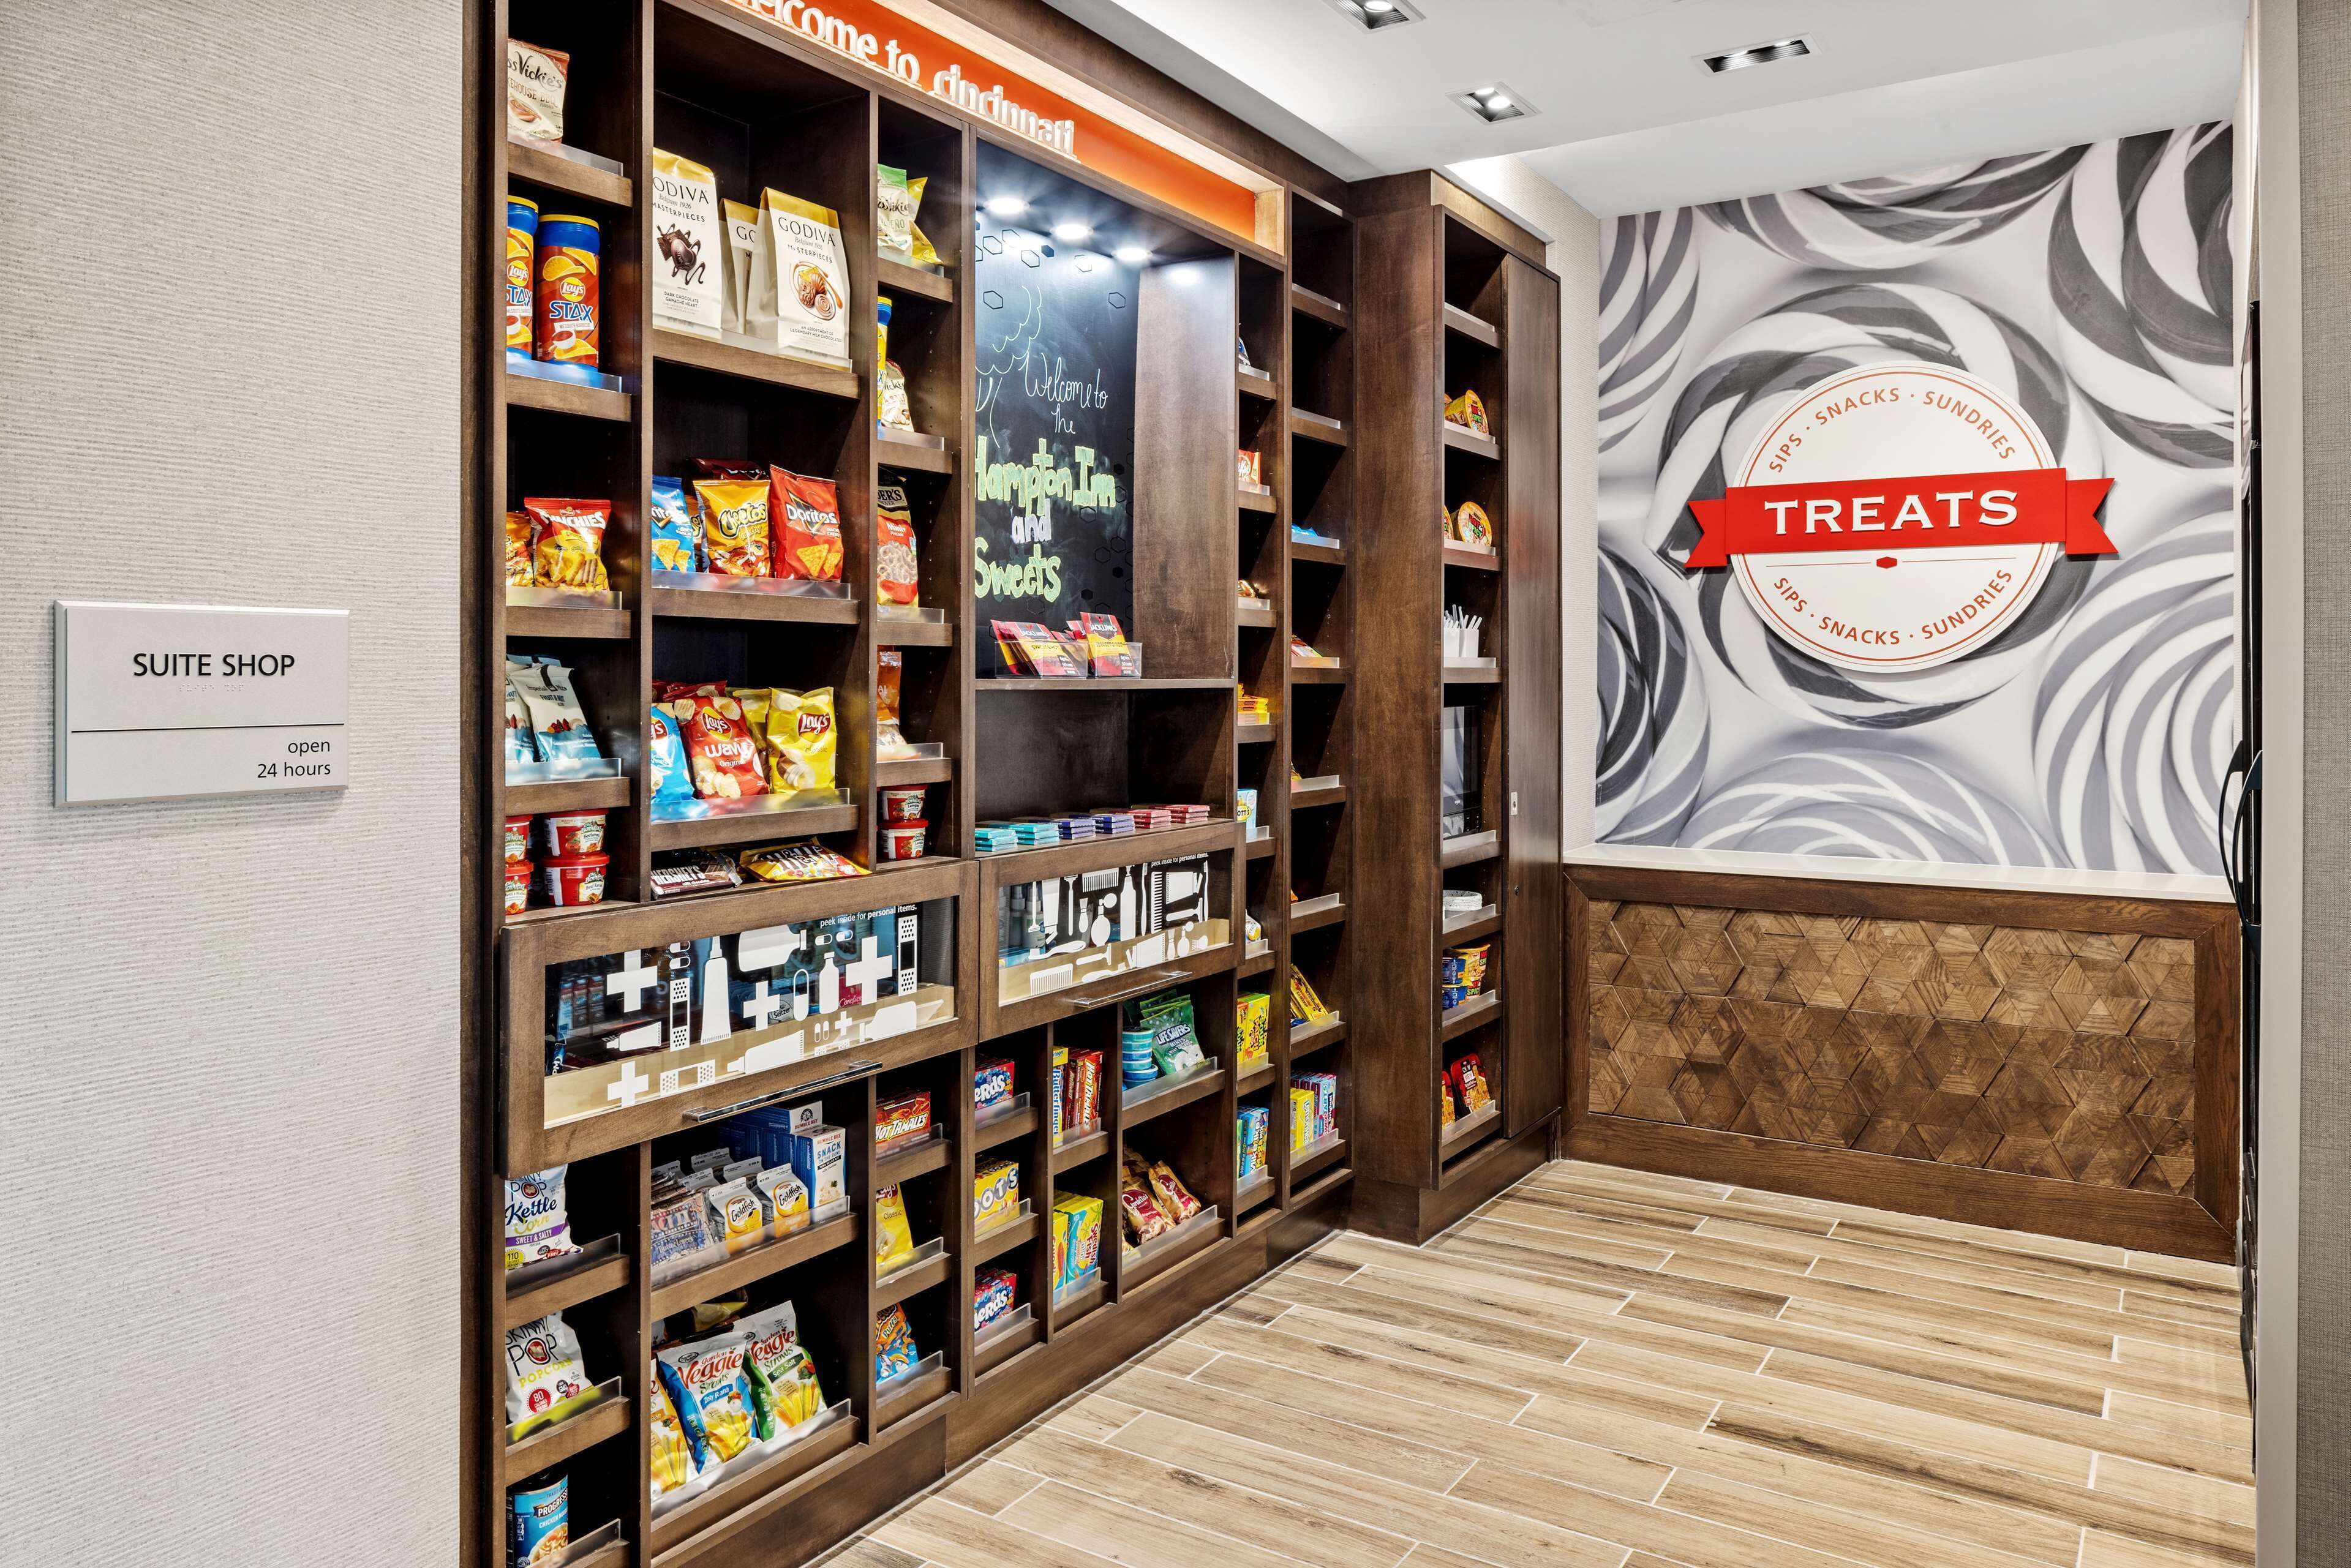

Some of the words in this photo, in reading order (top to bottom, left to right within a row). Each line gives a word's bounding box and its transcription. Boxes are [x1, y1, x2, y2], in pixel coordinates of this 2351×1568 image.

[886, 40, 920, 84] to
[933, 64, 1075, 157] cincinnati
[653, 176, 709, 204] ODIVA
[778, 216, 836, 247] GODIVA
[507, 284, 533, 309] TAX
[675, 294, 699, 304] CHOCOLATE
[550, 300, 593, 323] STAX
[1018, 351, 1091, 409] Welcome
[1093, 369, 1108, 409] to
[1768, 433, 1803, 474] SIPS
[1815, 387, 1900, 426] SNACKS
[1922, 391, 2016, 461] SUNDRIES
[975, 435, 1072, 517] Hampton
[1073, 446, 1116, 508] Inn
[878, 489, 903, 501] DER'S
[718, 501, 767, 539] Cheetos
[784, 503, 838, 524] Doritos
[1012, 498, 1052, 544] and
[1764, 490, 2020, 536] TREATS
[975, 536, 1062, 603] Sweets
[1774, 577, 1808, 613] SIPS
[1818, 616, 1900, 646] SNACKS
[1921, 569, 2013, 641] SUNDRIES
[133, 653, 212, 677] SUITE
[222, 653, 296, 677] SHOP
[705, 713, 731, 733] Lay's
[799, 711, 830, 735] Lay's
[288, 739, 331, 757] open
[257, 763, 278, 779] 24
[284, 762, 331, 777] hours
[1179, 854, 1197, 863] personal
[821, 917, 836, 929] peek
[837, 913, 856, 924] inside
[856, 912, 867, 920] for
[867, 906, 896, 920] personal
[897, 904, 917, 913] items.
[773, 1006, 791, 1018] Seltzer
[891, 1112, 928, 1136] TAMALES
[817, 1141, 841, 1160] SNACK
[511, 1181, 547, 1202] POP
[779, 1184, 802, 1206] Goldfish
[505, 1196, 557, 1226] Kettle
[731, 1198, 756, 1223] Goldfish
[883, 1209, 903, 1220] Classic
[516, 1235, 533, 1245] SWEET
[539, 1229, 552, 1240] SALTY
[1085, 1234, 1093, 1259] Fish
[1089, 1222, 1099, 1265] Swedish
[507, 1251, 519, 1260] 110
[507, 1334, 559, 1376] POP
[701, 1350, 728, 1367] garden
[748, 1327, 797, 1366] Veggie
[518, 1357, 574, 1389] POPCORN
[677, 1349, 743, 1390] Veggie
[772, 1366, 784, 1378] Sea
[784, 1358, 797, 1370] Salt
[699, 1372, 730, 1395] Straws
[533, 1390, 544, 1402] 80
[539, 1513, 559, 1529] CHICKEN
